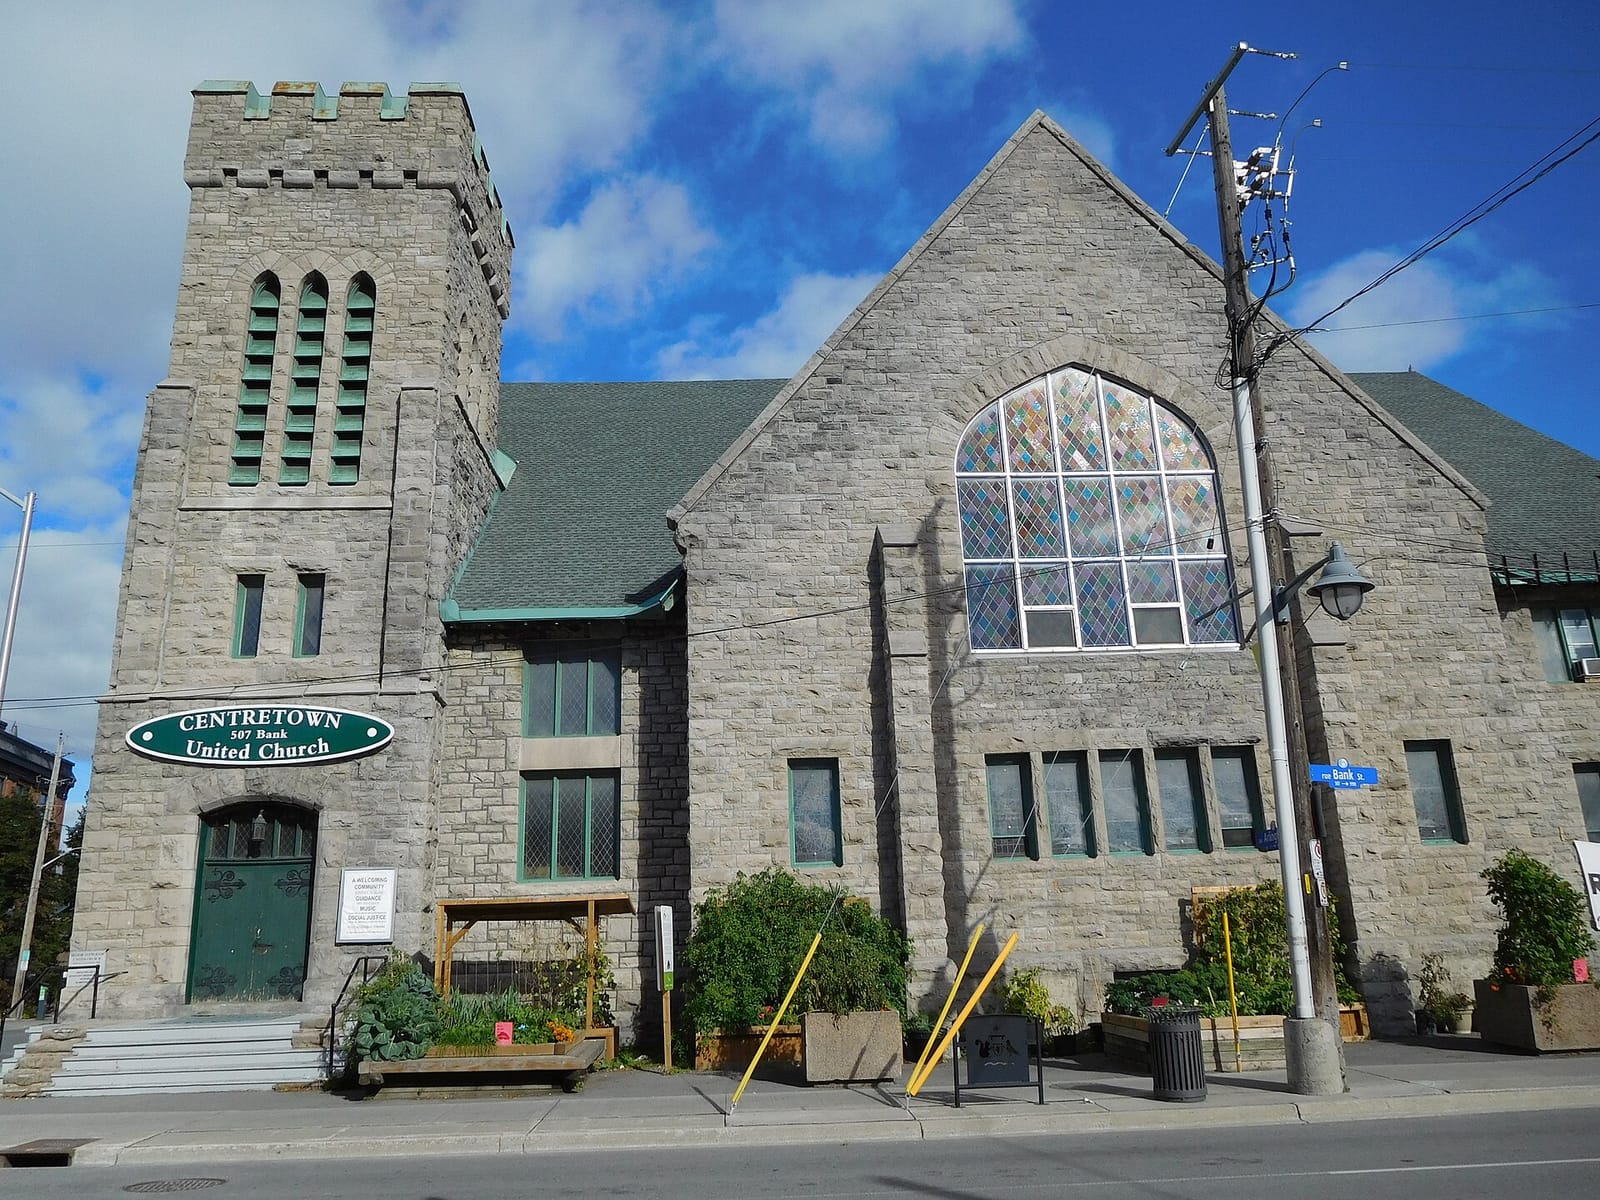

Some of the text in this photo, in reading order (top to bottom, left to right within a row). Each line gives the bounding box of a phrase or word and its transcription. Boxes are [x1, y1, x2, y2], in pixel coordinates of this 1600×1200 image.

[179, 709, 342, 731] CENTRETOWN
[230, 729, 288, 740] 507 Bank
[186, 738, 330, 760] United Church
[1332, 769, 1354, 780] Bank
